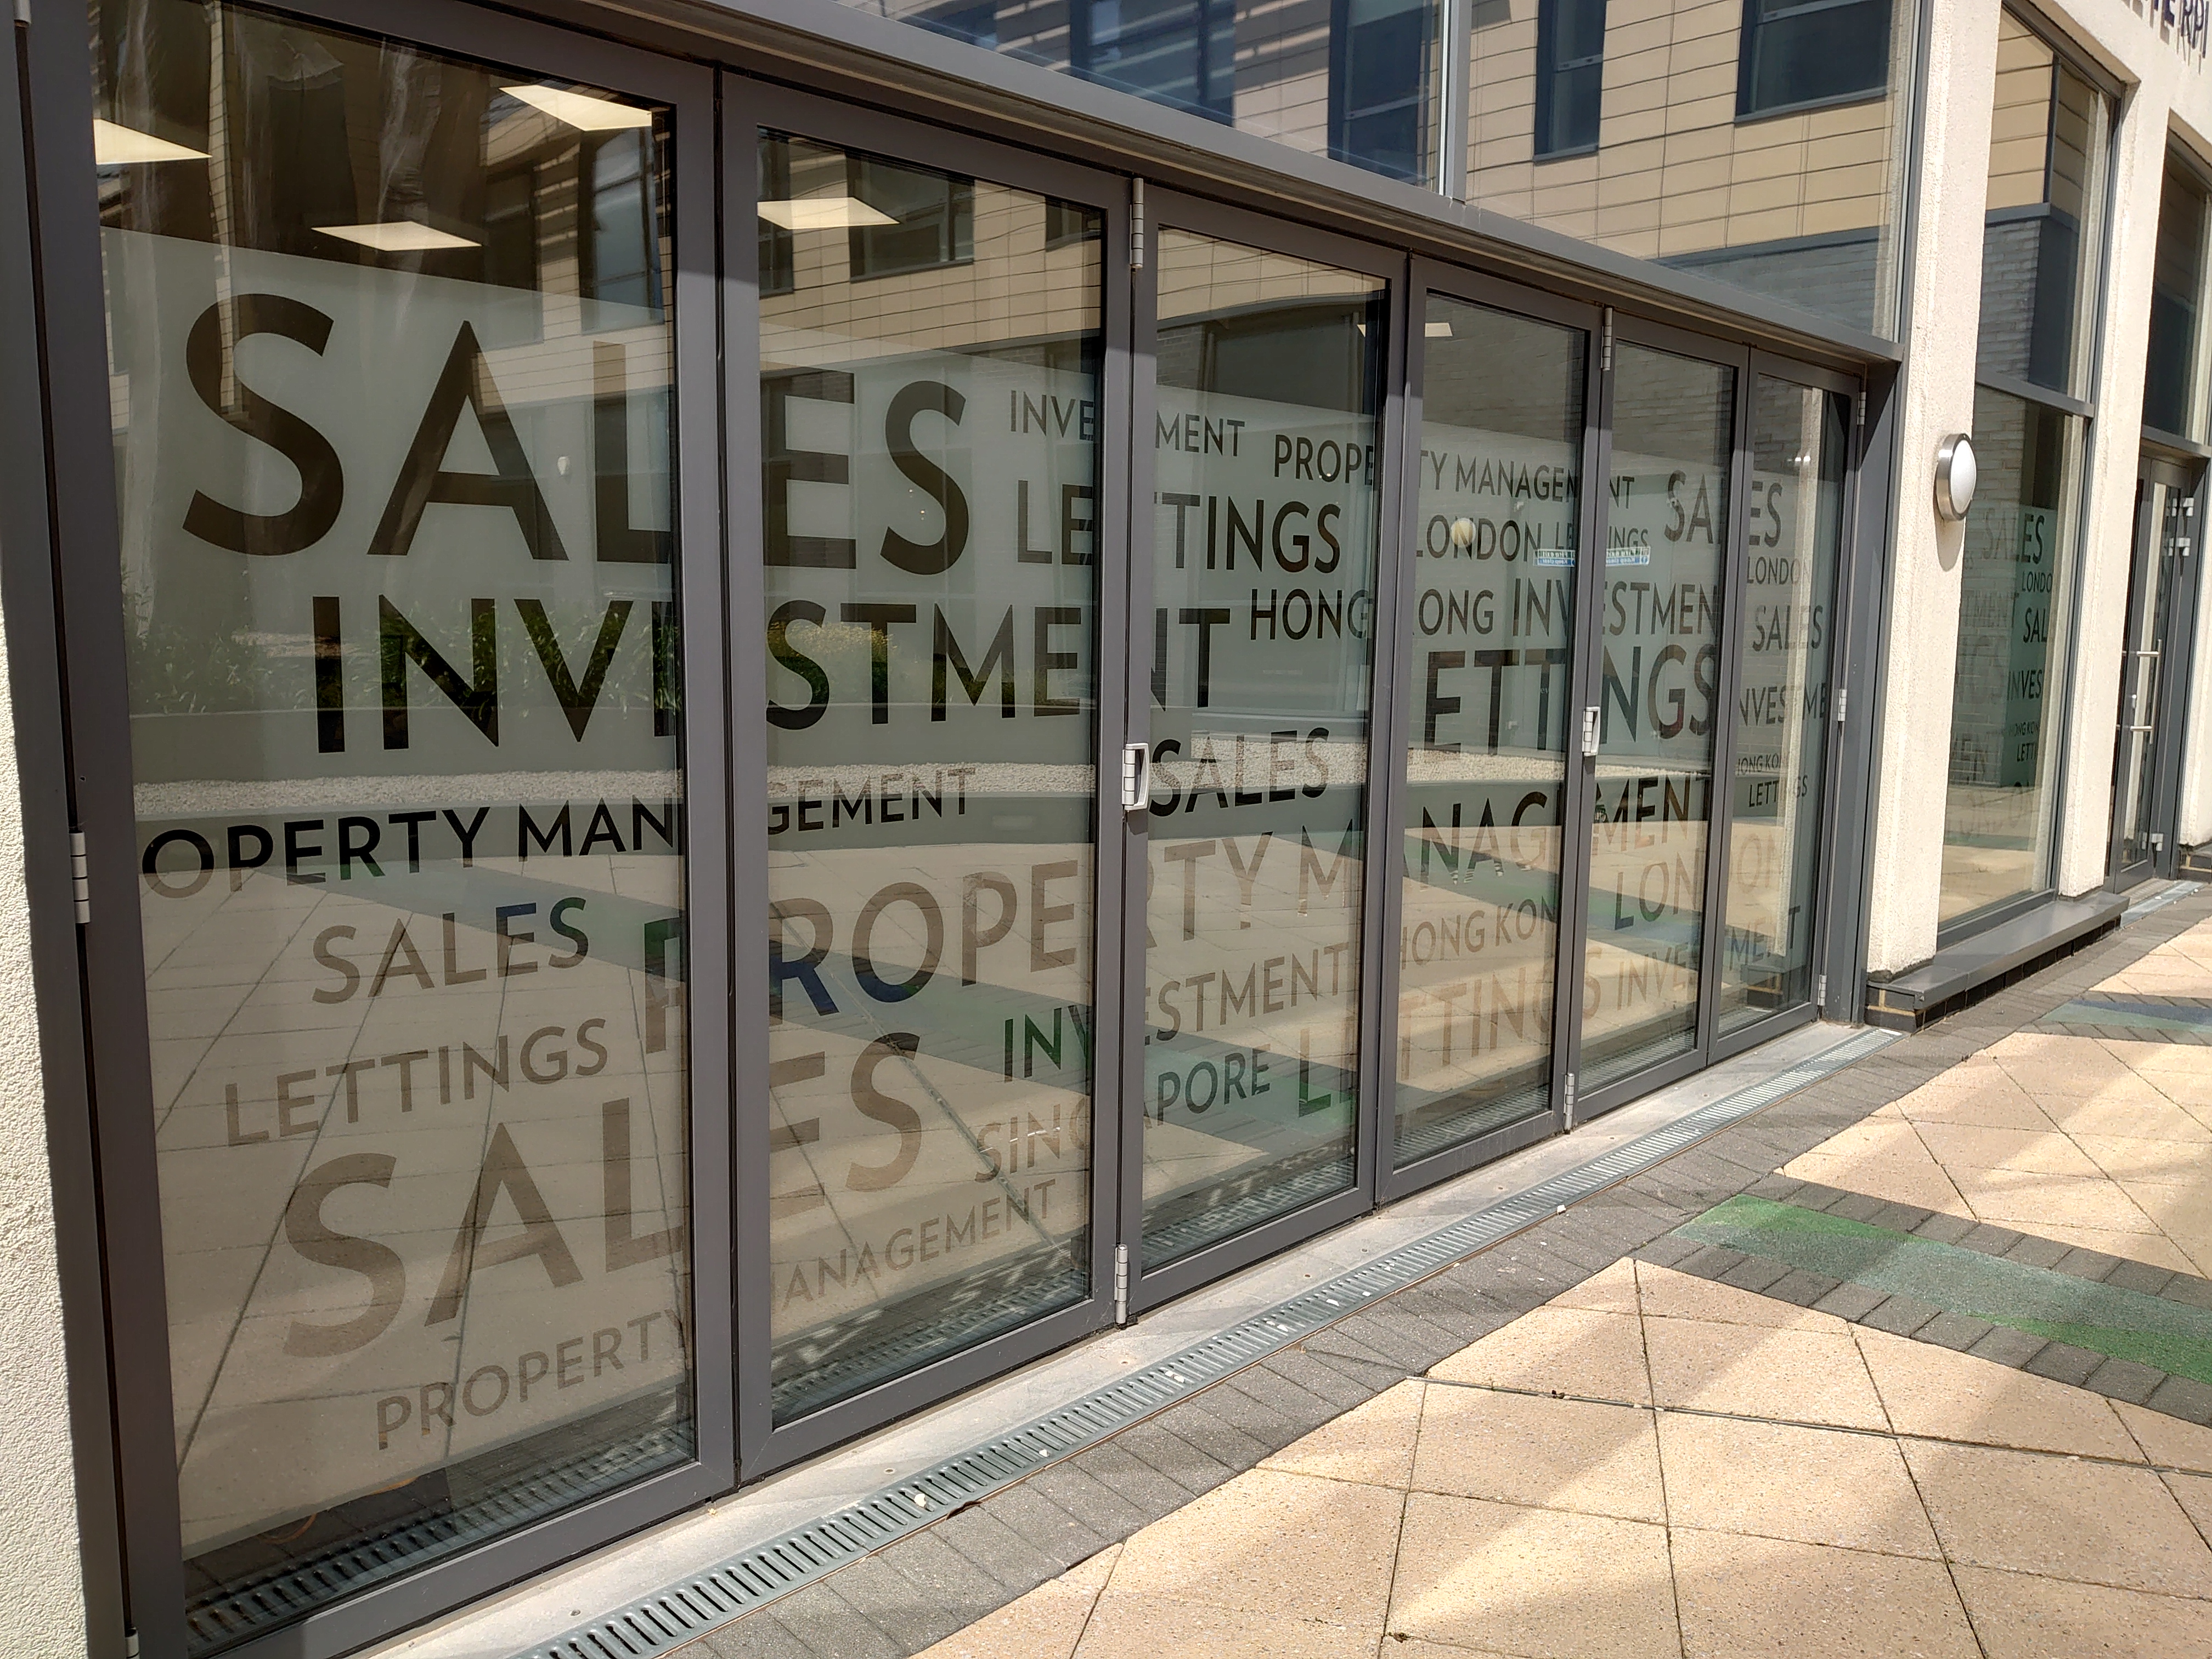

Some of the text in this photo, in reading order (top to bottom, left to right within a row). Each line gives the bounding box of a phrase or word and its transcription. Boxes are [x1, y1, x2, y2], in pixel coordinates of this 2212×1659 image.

[182, 294, 969, 575] SALES
[1010, 390, 1245, 456] INVEMENT
[1274, 434, 1635, 509] PROPEY MANAGENT
[1664, 470, 1783, 549] SAES
[1018, 479, 1341, 574] LETINGS
[1416, 515, 1542, 562] ONDON
[1413, 588, 1494, 635] ONG
[1513, 577, 1718, 637] INVSTMEN
[2021, 571, 2053, 593] LONDO
[2023, 607, 2048, 643] SAL
[1752, 605, 1824, 652] SALS
[1408, 644, 1716, 755] ETTNGS
[518, 768, 976, 863] MANGEMENT
[1149, 727, 1329, 817] SALES
[311, 896, 590, 1005] SALES
[644, 831, 1273, 1054] ROPETY
[1496, 895, 1557, 947] KON
[1004, 942, 1348, 1084] INVSTMENT
[225, 1018, 607, 1147] LETTINGS
[974, 1043, 1271, 1184] SINGPORE
[771, 1179, 1056, 1312] ANAGEMENT
